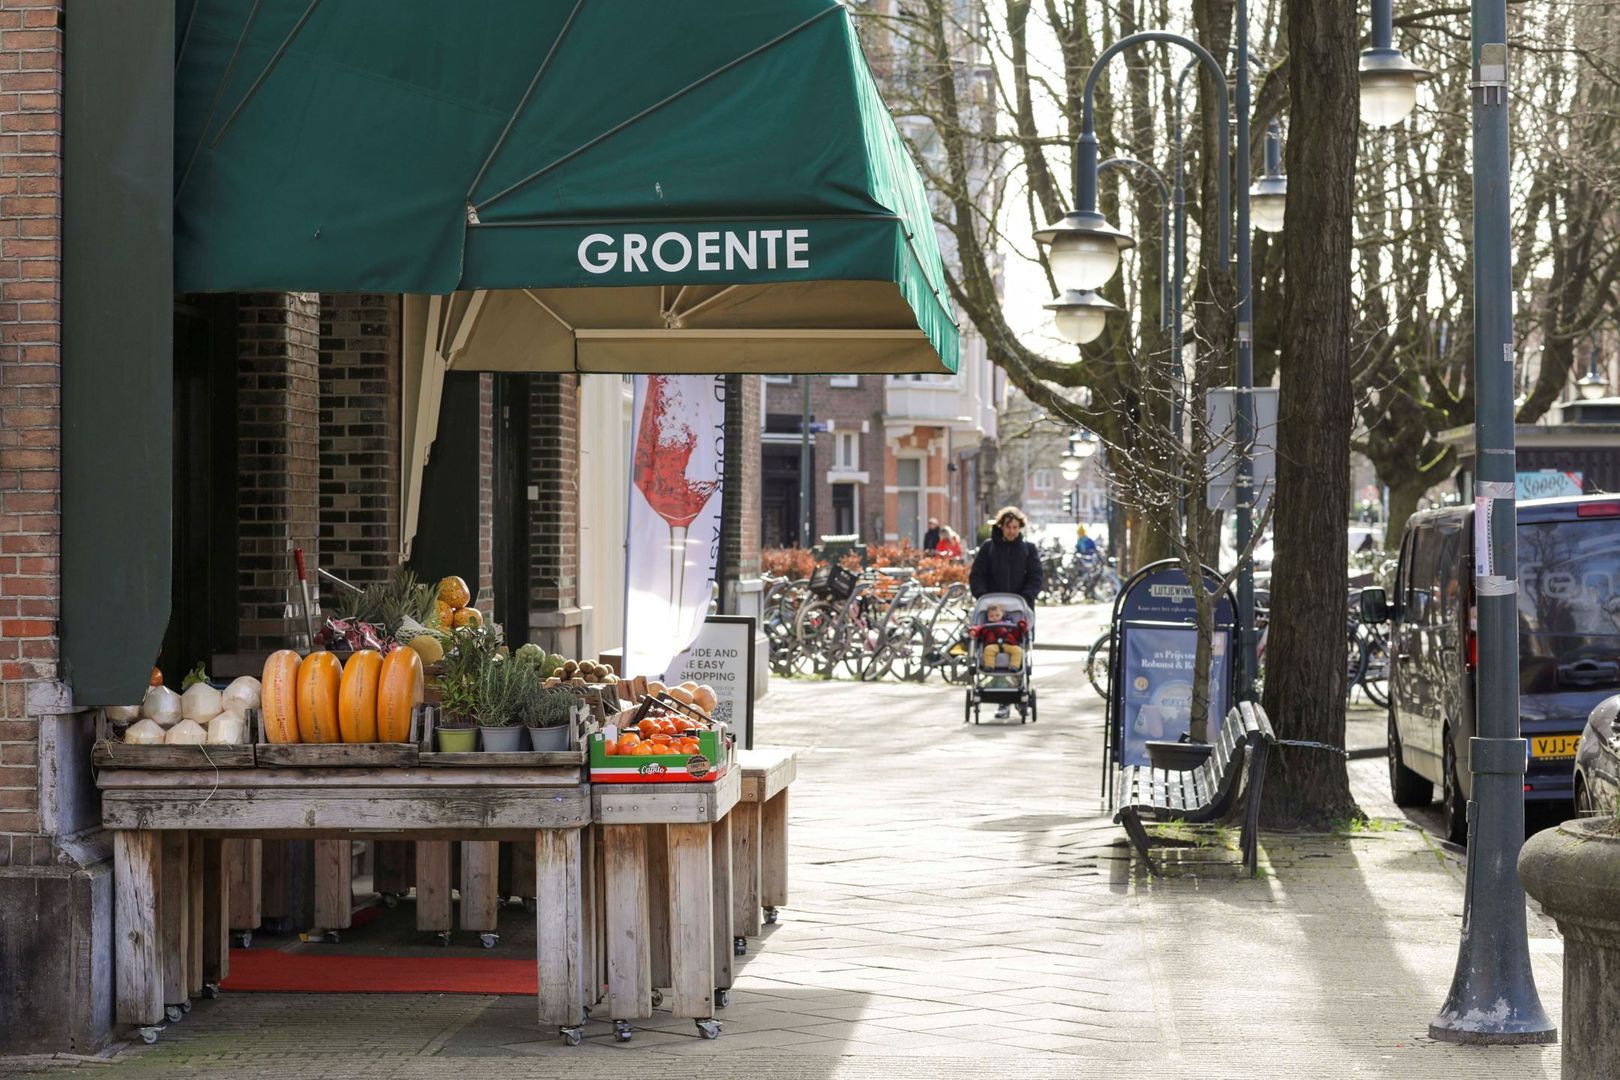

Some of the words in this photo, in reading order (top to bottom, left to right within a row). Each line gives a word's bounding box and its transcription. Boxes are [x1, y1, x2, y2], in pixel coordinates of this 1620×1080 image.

[577, 229, 809, 274] GROENTE
[714, 422, 725, 493] YOUR
[706, 514, 721, 590] TASTE
[714, 649, 738, 658] AND
[698, 660, 725, 669] EASY
[1175, 661, 1183, 669] &
[680, 671, 736, 681] SHOPPING
